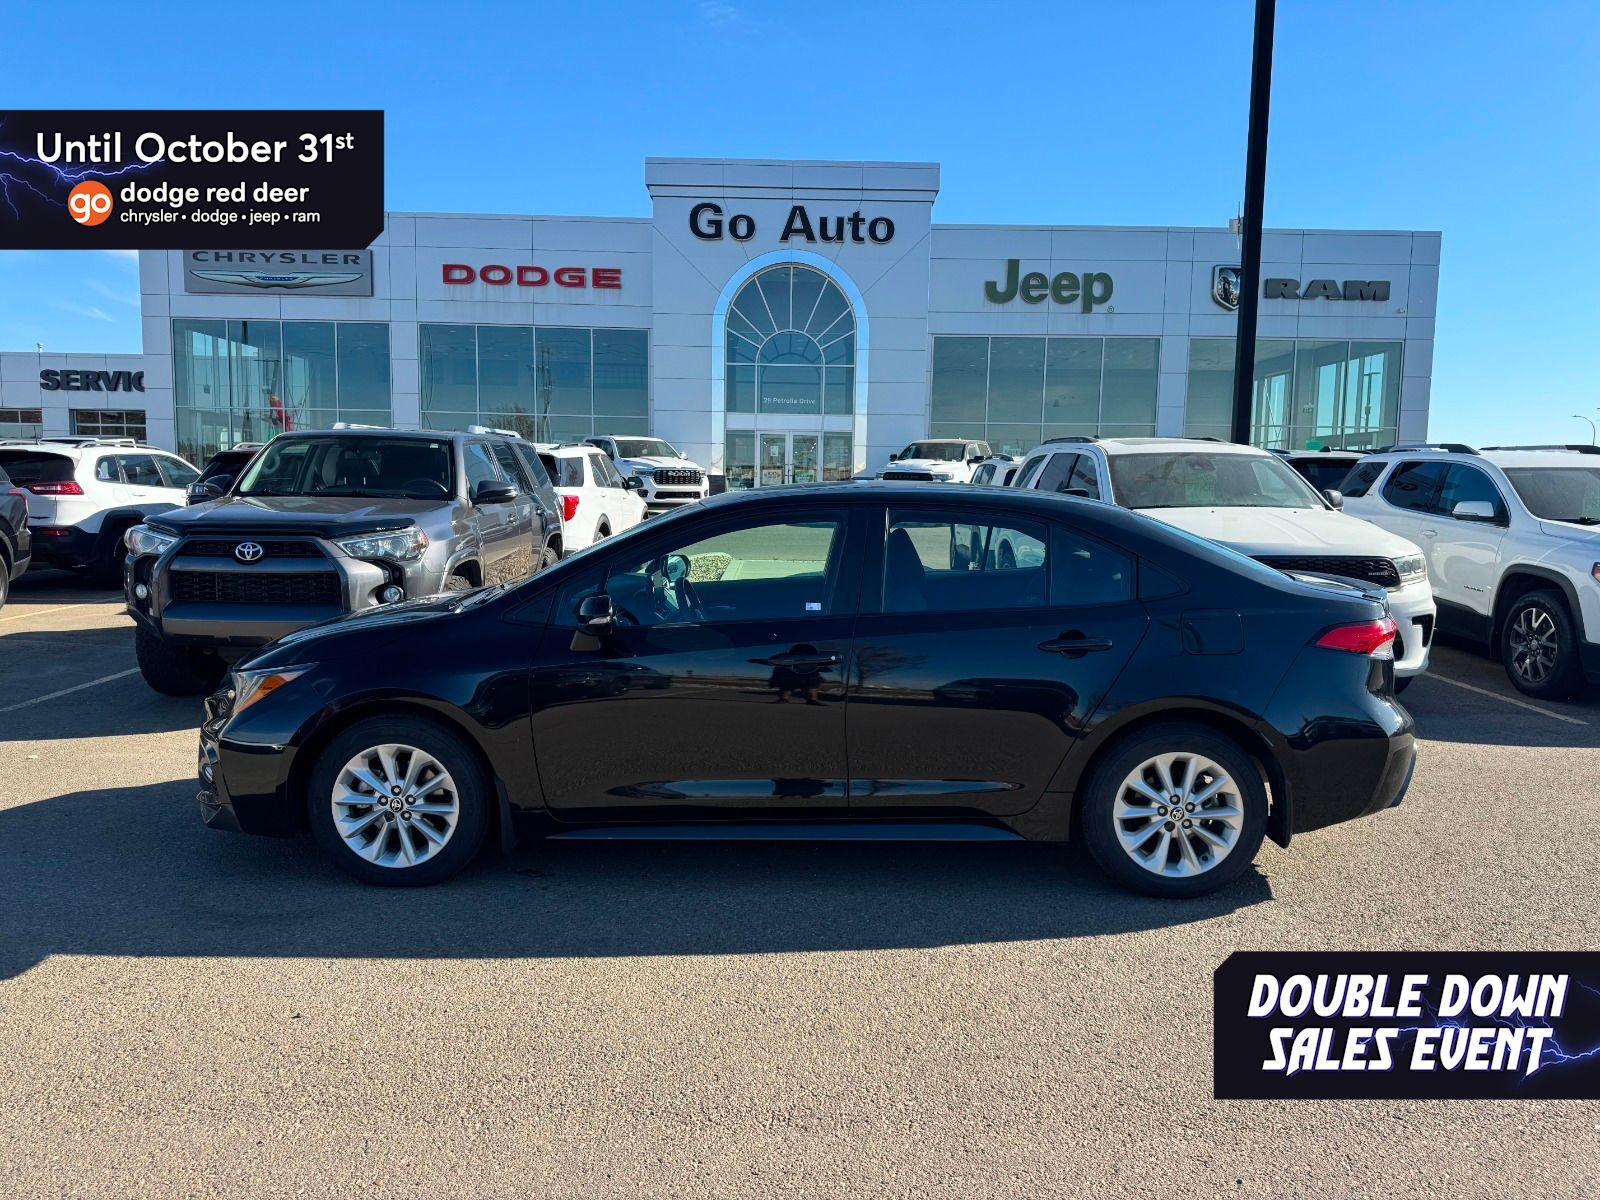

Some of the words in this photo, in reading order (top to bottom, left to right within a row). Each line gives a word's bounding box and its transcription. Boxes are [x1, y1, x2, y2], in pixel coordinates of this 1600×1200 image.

[689, 202, 756, 241] Go
[779, 205, 895, 244] Auto
[191, 251, 361, 265] CHRYSLER
[442, 263, 622, 289] DODGE
[984, 259, 1113, 314] Jeep
[1264, 277, 1391, 302] RAM
